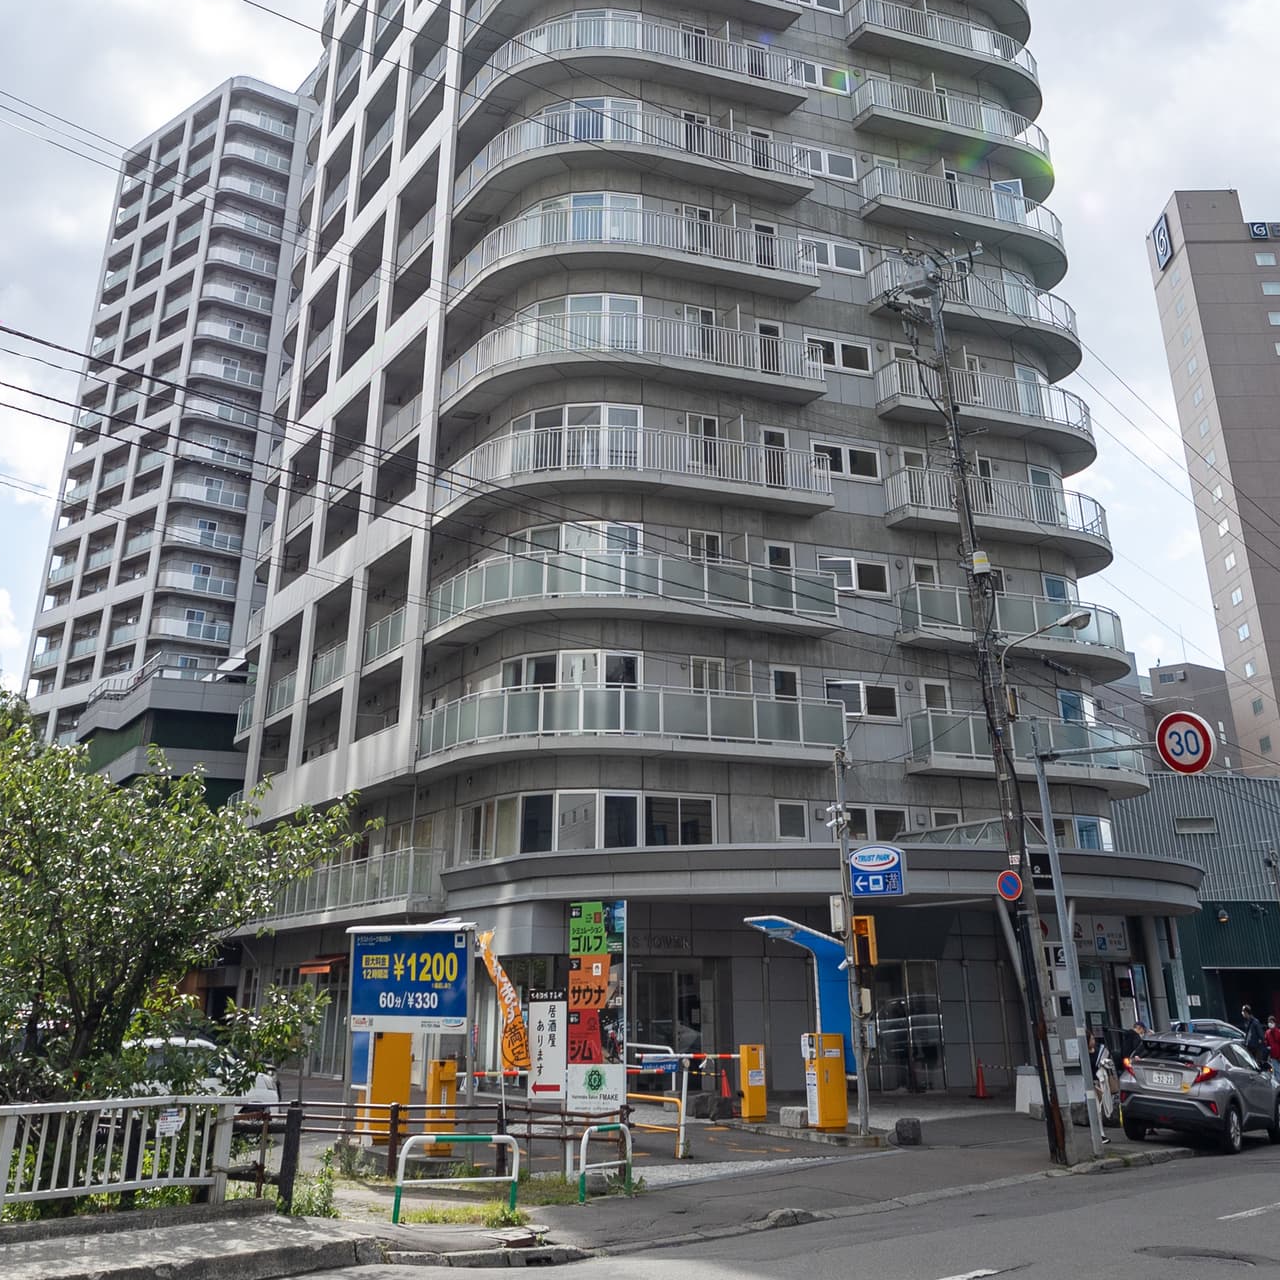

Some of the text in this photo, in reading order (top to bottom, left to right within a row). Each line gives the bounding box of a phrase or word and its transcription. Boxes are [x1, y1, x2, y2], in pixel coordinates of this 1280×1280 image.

[1169, 730, 1200, 756] 30
[572, 935, 603, 952] ゴルフ
[393, 952, 458, 982] ¥1200
[571, 985, 605, 1005] サウナ
[548, 1004, 557, 1047] 居酒屋
[536, 1020, 546, 1077] あります
[570, 1040, 593, 1061] ジム
